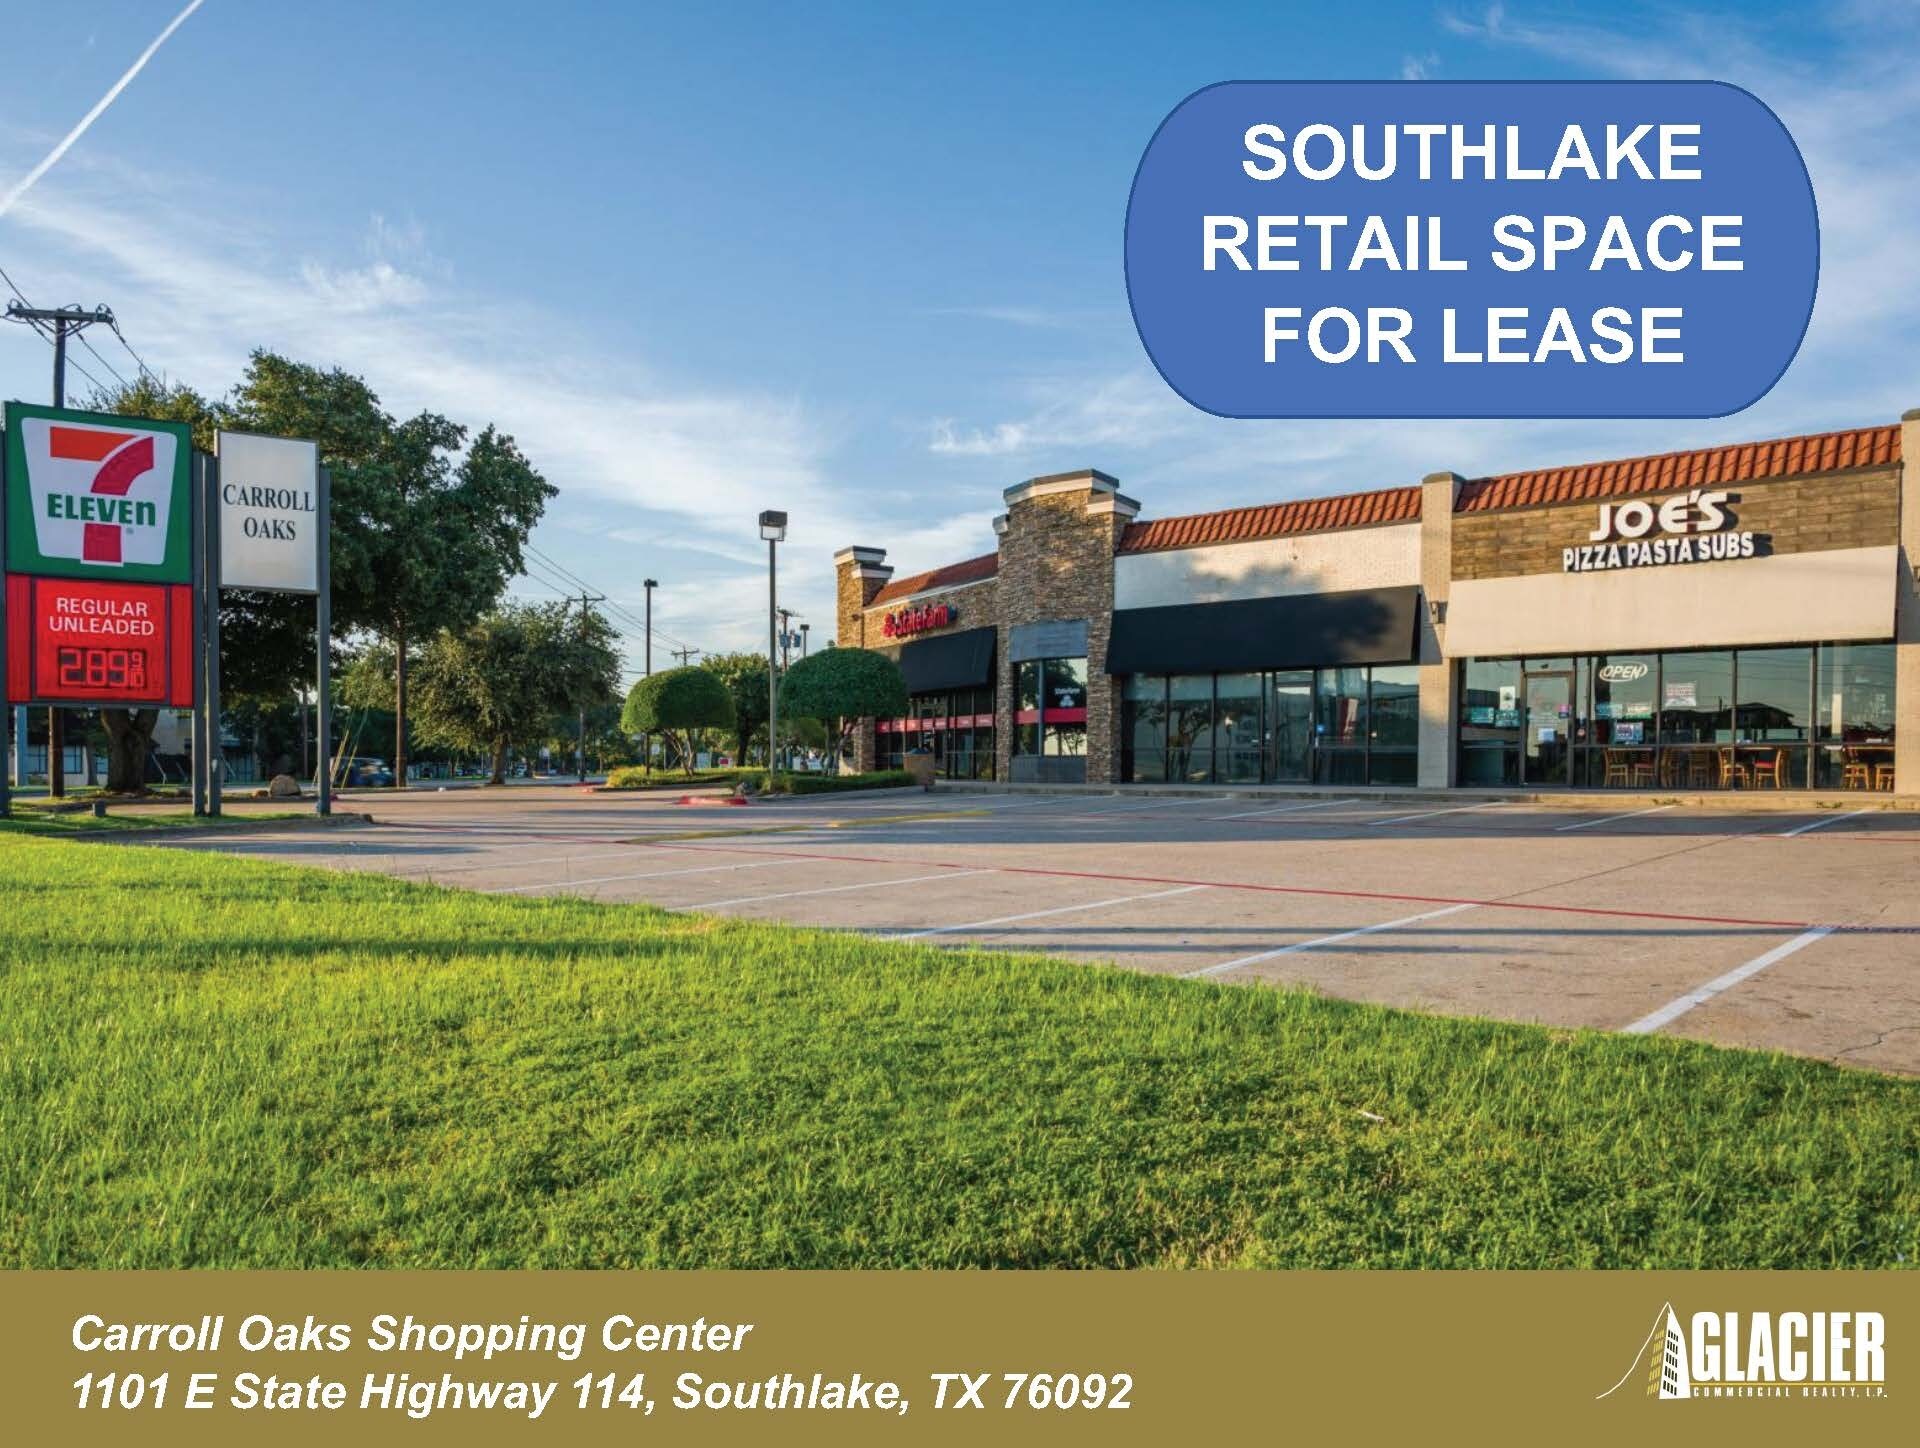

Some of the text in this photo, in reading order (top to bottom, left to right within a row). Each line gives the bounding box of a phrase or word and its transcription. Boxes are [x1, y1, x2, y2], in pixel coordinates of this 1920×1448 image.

[223, 483, 316, 513] CARROLL
[1590, 489, 1729, 542] JOE'S
[243, 516, 297, 541] OAKS
[1562, 532, 1755, 573] PIZZA PASTA SUBS
[56, 597, 148, 617] REGULAR
[49, 616, 155, 636] UNLEADED
[1603, 664, 1642, 680] OPEN
